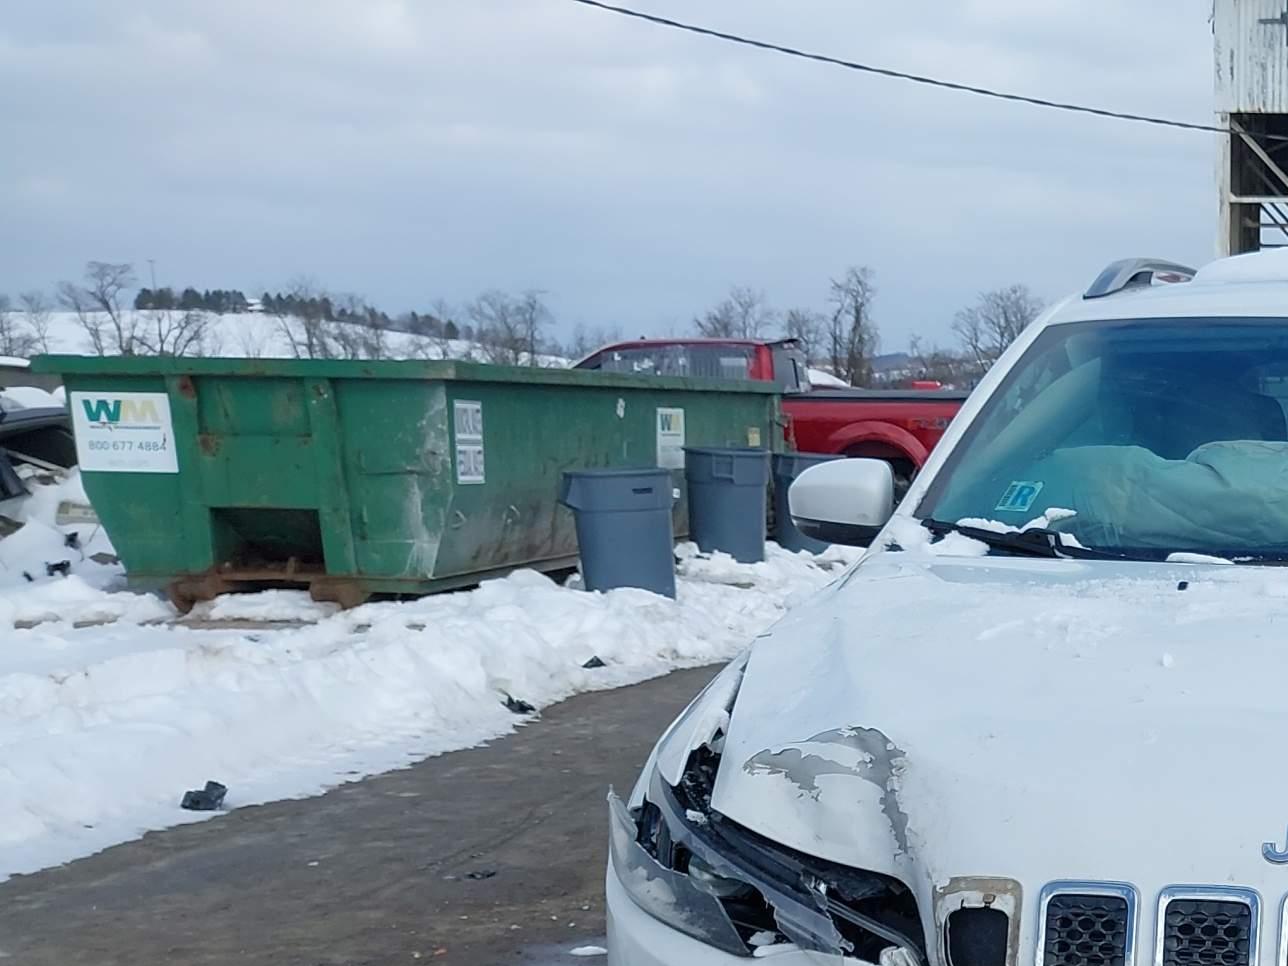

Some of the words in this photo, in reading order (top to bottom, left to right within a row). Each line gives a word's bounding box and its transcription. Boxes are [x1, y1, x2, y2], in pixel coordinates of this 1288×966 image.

[81, 399, 163, 422] WM
[88, 440, 109, 451] 800
[112, 441, 134, 451] 677
